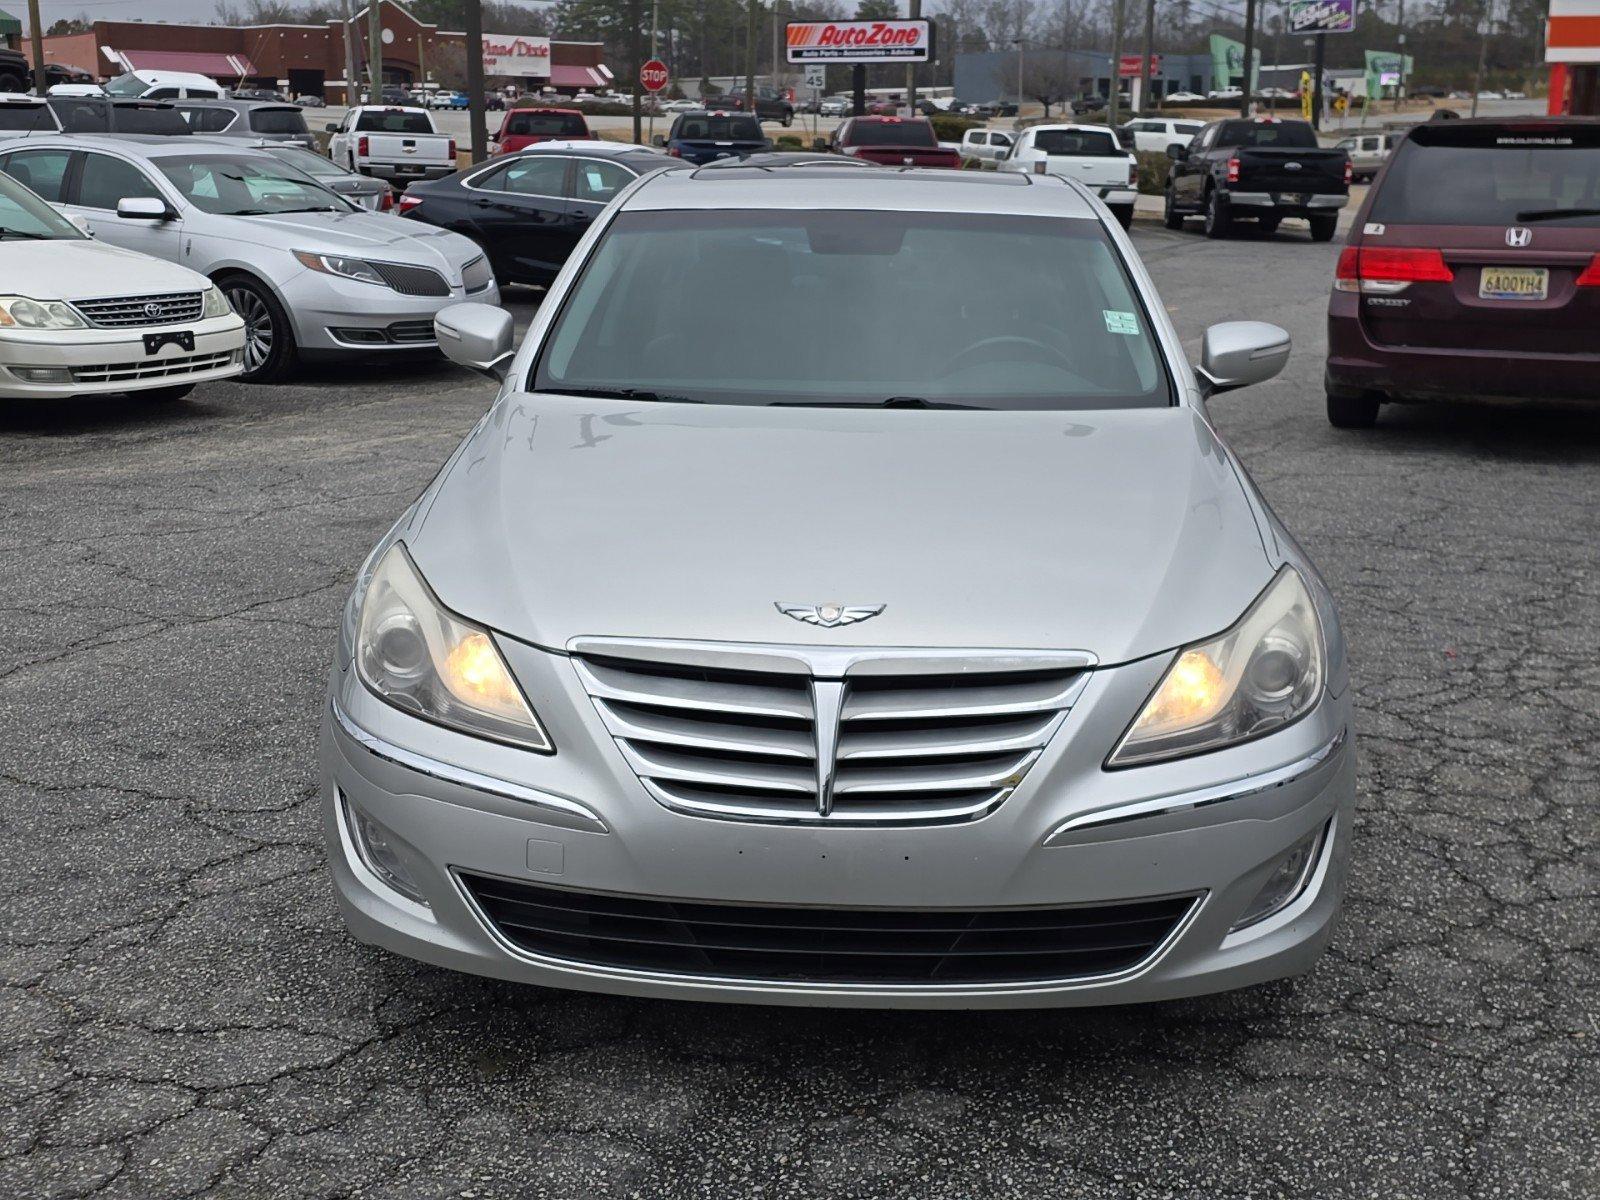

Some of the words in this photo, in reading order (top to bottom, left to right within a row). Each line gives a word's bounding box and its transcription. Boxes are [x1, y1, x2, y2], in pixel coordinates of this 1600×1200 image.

[818, 24, 919, 45] AutoZone
[641, 69, 666, 81] STOP
[806, 76, 823, 87] 45
